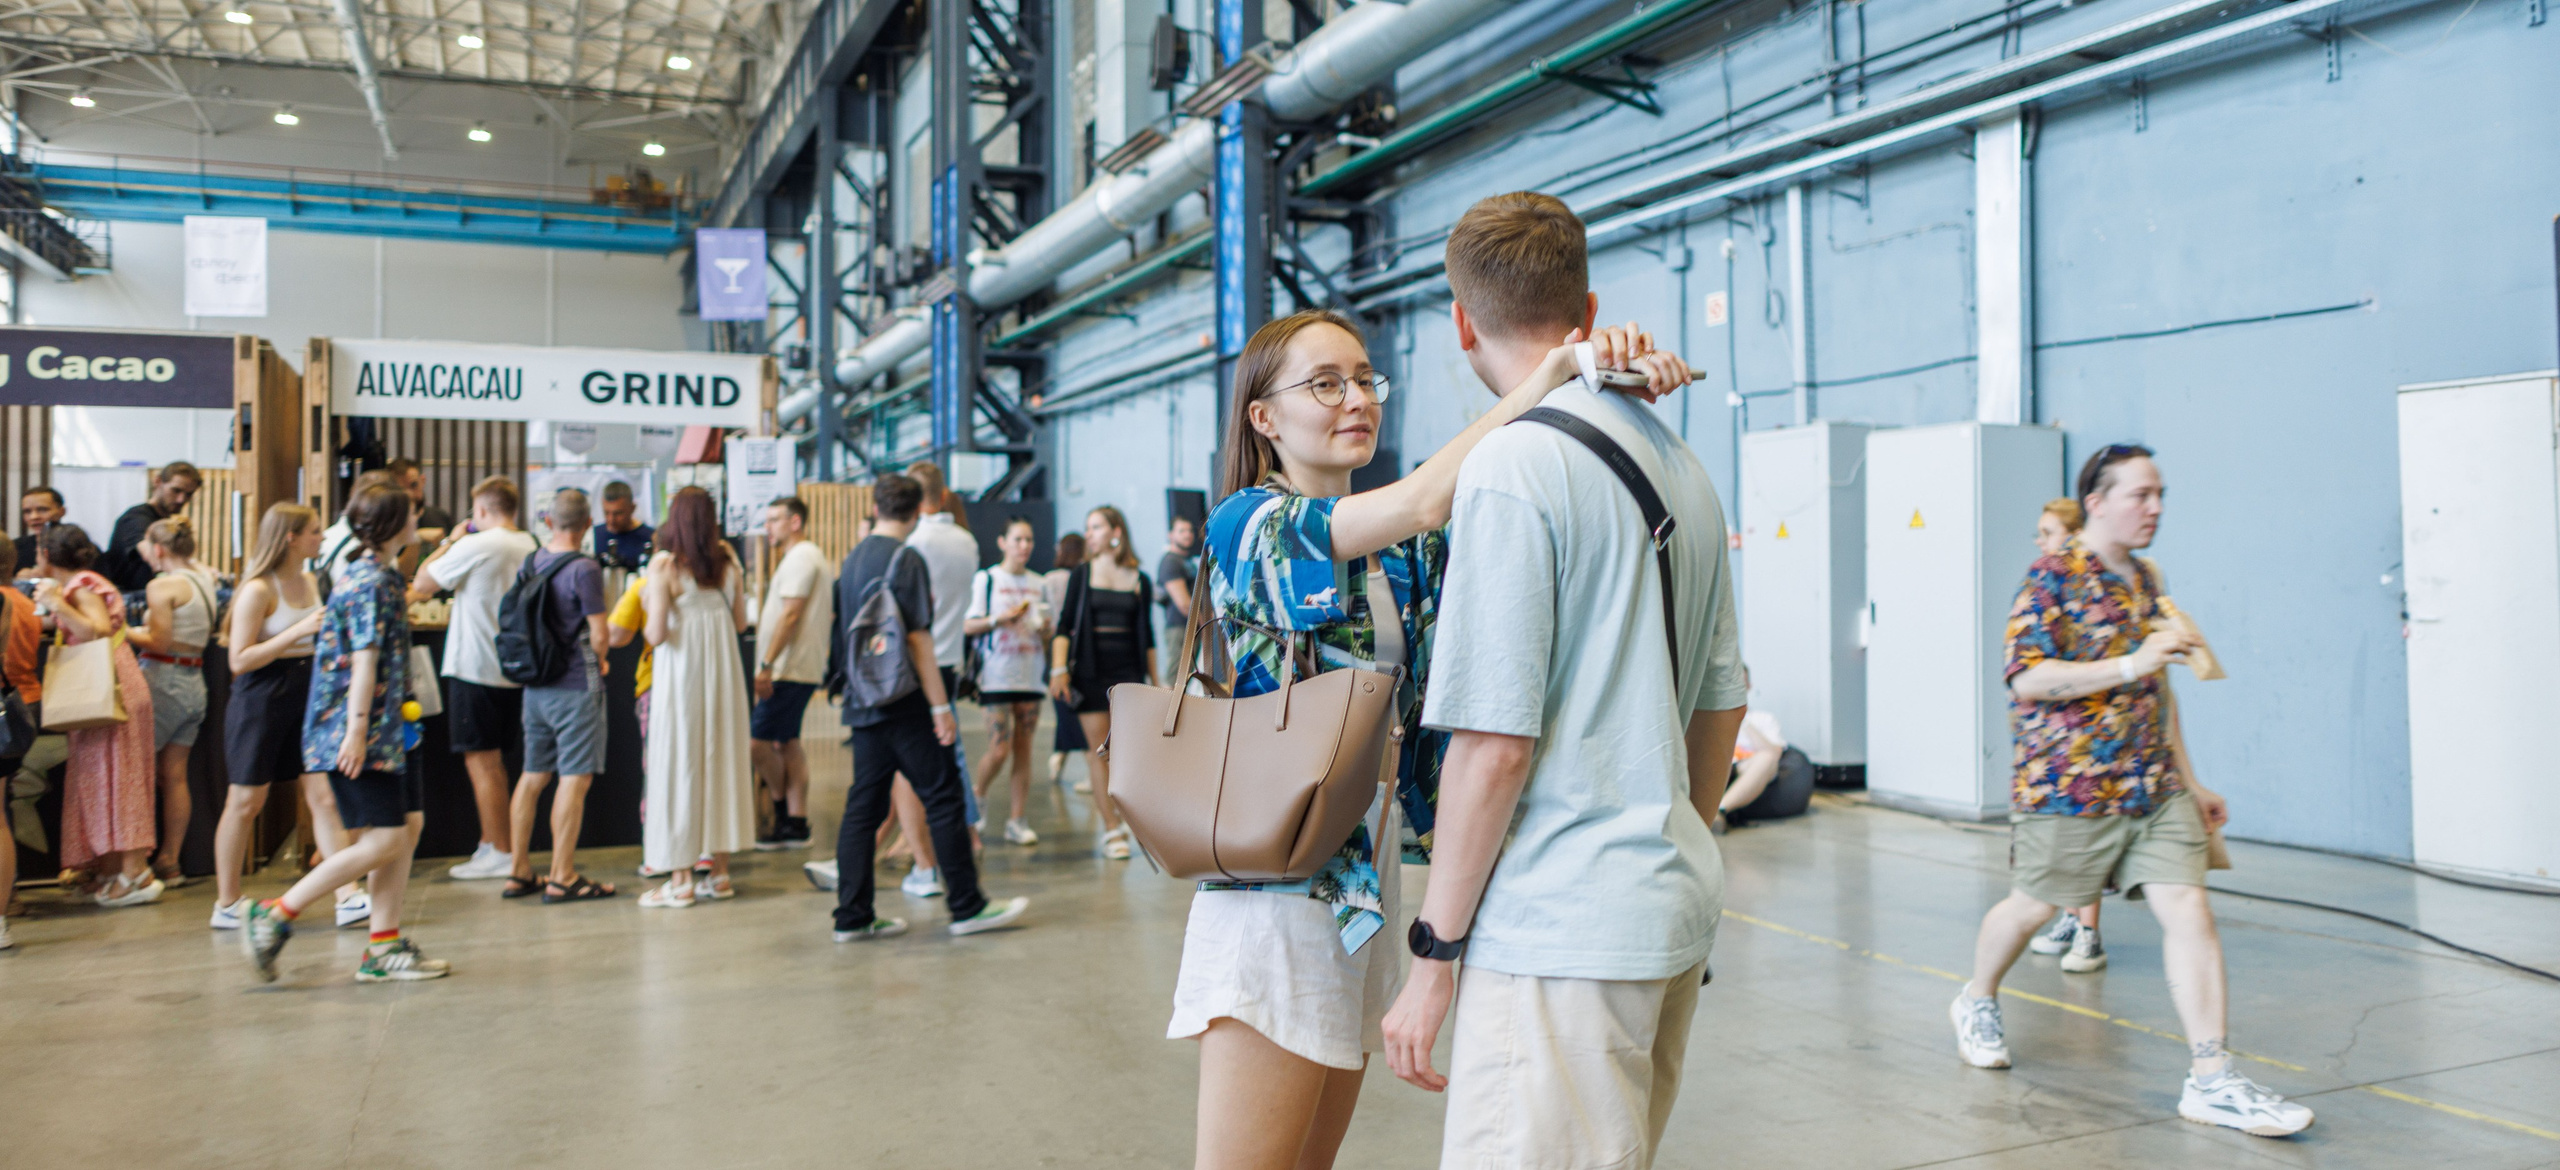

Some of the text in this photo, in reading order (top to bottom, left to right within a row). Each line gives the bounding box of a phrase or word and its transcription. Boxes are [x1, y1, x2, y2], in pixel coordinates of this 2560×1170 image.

[26, 345, 176, 383] Cacao
[356, 362, 522, 401] ALVACACAU
[581, 370, 741, 407] GRIND
